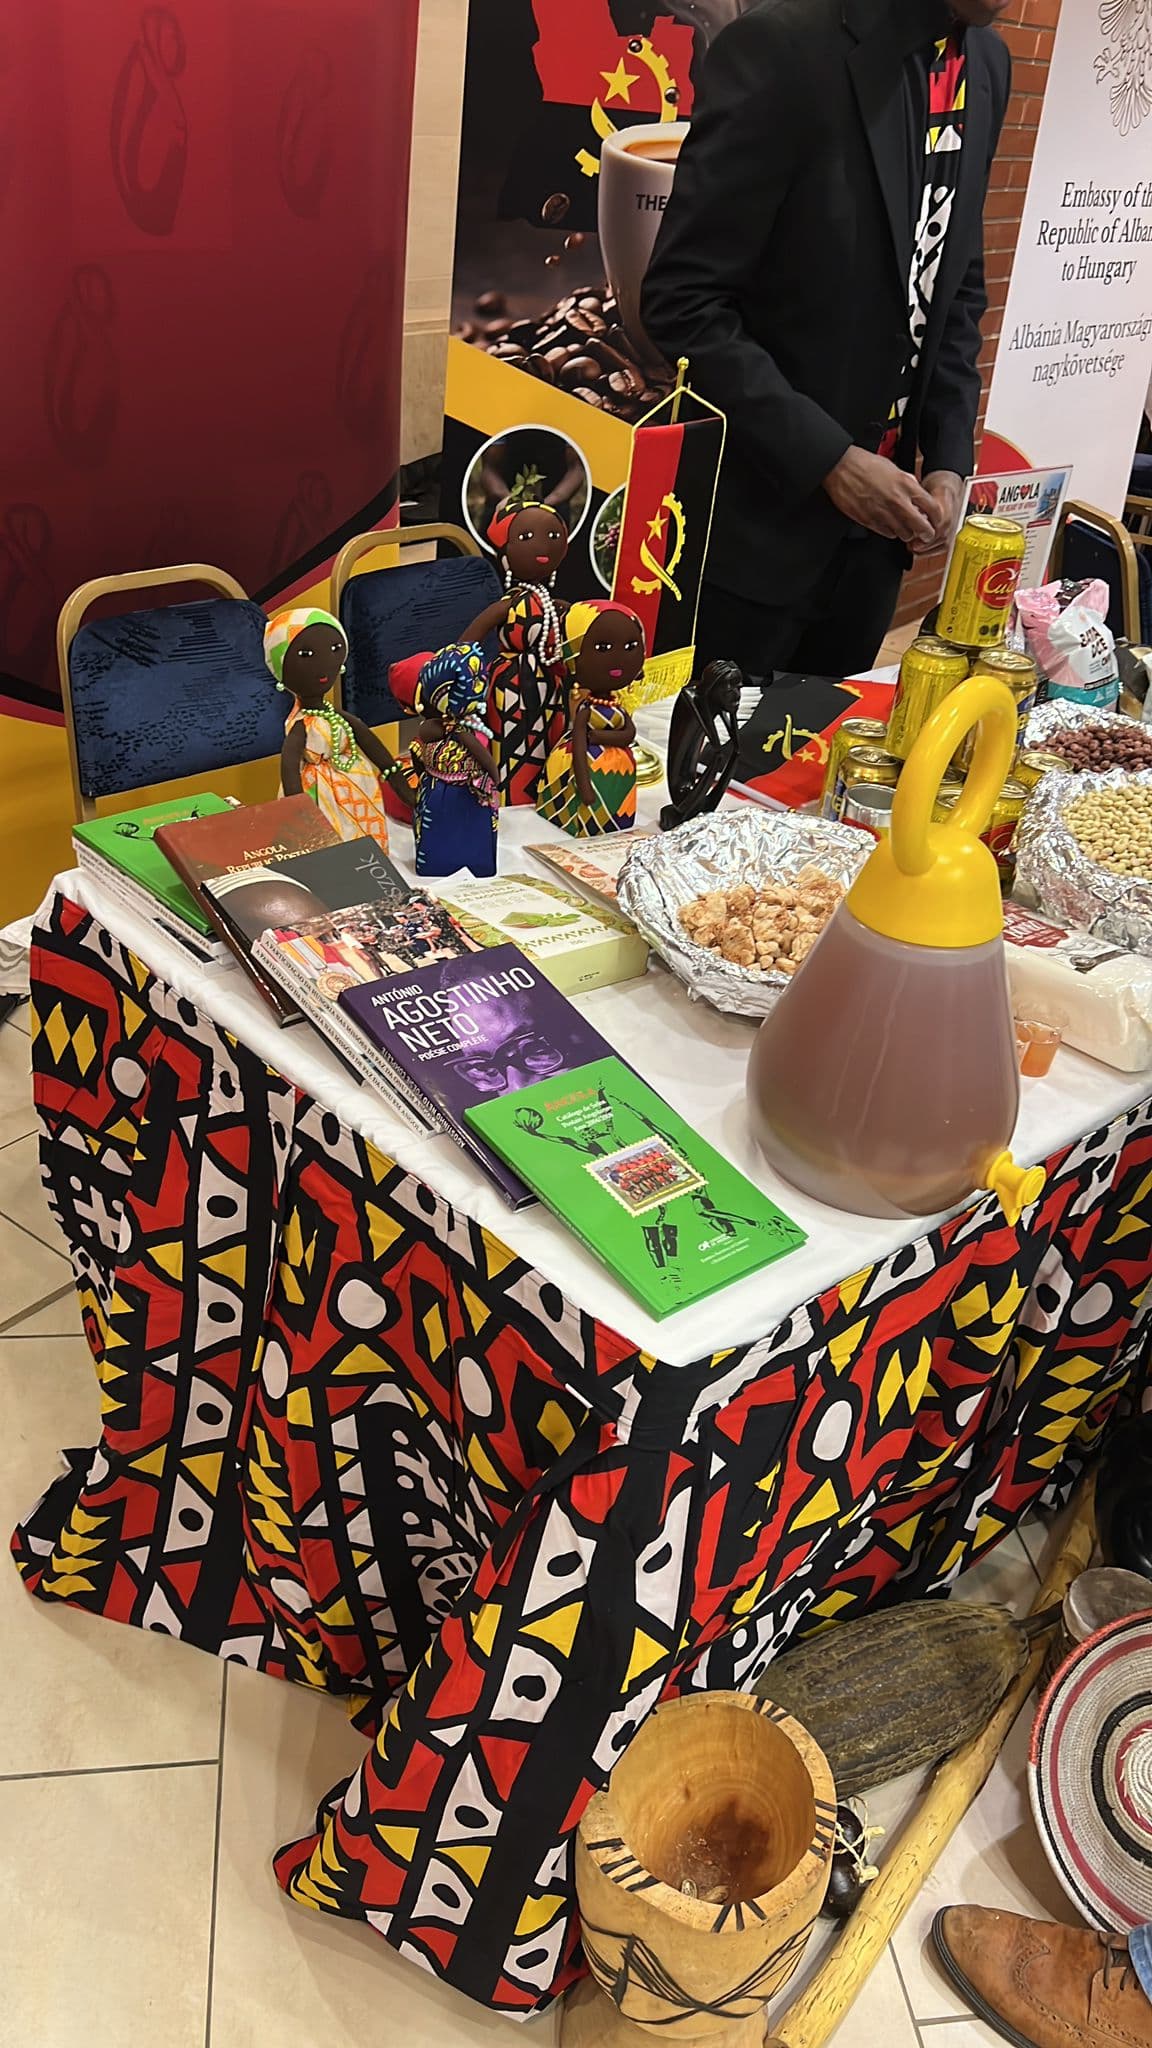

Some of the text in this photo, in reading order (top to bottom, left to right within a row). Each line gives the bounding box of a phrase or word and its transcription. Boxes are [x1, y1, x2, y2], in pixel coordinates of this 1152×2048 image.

[635, 193, 668, 211] THE
[1060, 180, 1122, 215] Embassy
[1123, 182, 1144, 208] of
[1036, 218, 1100, 253] Republic
[1101, 217, 1121, 243] of
[1062, 255, 1138, 285] to Hungary
[1008, 322, 1063, 350] Albánia
[243, 844, 288, 861] ANGOLA
[371, 983, 424, 1008] ANTÓNIO
[382, 967, 536, 1031] AGOSTINHO
[397, 1012, 480, 1053] NETO
[418, 1034, 489, 1062] POÉSIE COMPLÈTE
[420, 1095, 439, 1116] NETO
[433, 1111, 466, 1148] AGOSTINHO
